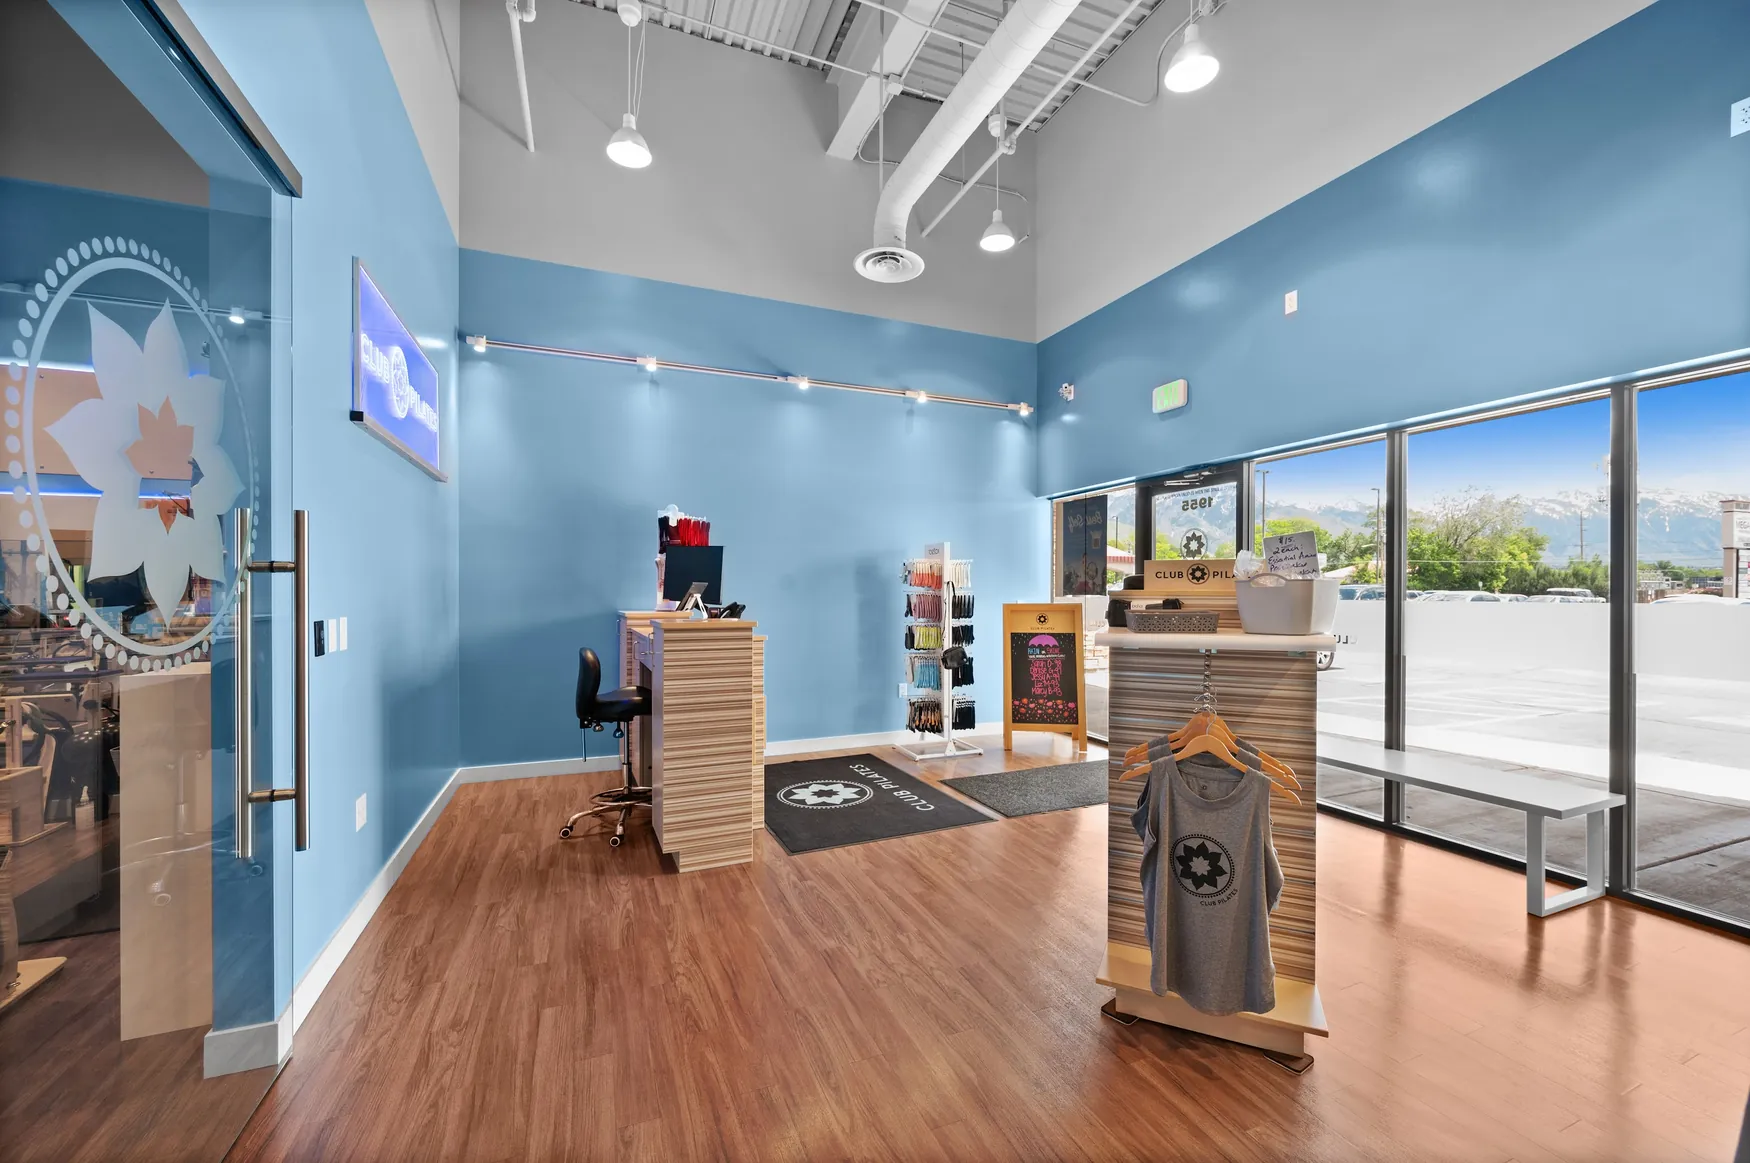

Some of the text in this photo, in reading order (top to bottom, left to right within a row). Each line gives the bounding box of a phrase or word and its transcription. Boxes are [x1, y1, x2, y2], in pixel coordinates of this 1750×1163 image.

[361, 333, 437, 433] CLUB PILATES
[1155, 571, 1184, 579] CLUB
[849, 764, 935, 811] CLUB PILATES
[1217, 888, 1239, 905] PILATES
